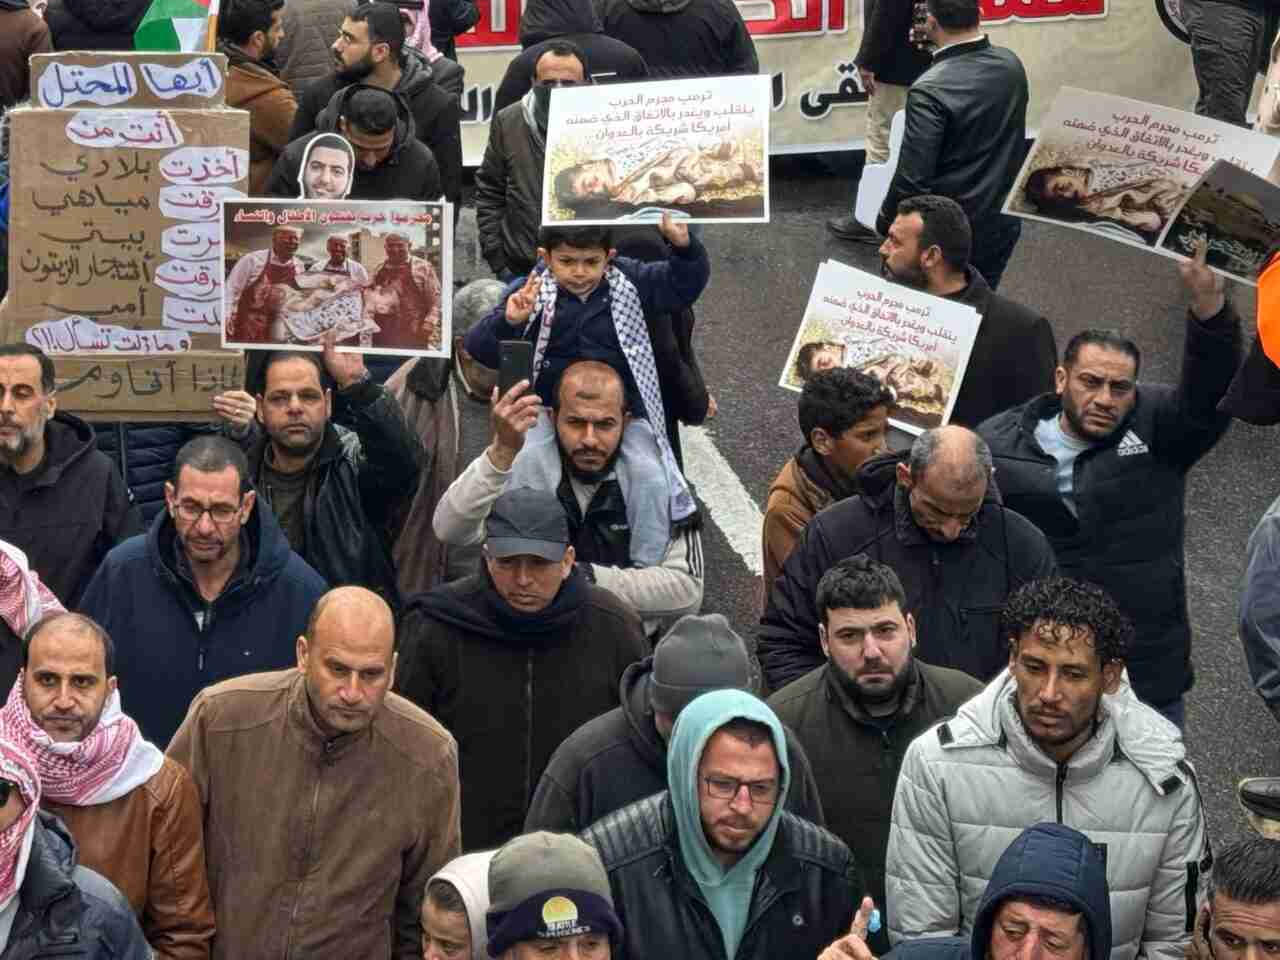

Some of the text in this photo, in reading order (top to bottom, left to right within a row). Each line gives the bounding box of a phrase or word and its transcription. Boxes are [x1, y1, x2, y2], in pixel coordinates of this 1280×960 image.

[43, 58, 217, 107] أيها المحتل
[566, 104, 754, 125] ينقلب ويغدر بالاتفاق الذي ضمنه
[608, 90, 712, 109] ترمب مجرم الحرب
[70, 111, 177, 144] أنت من
[595, 121, 731, 140] أمريكا شريكة بالعدوان
[1063, 118, 1209, 162] ويغدر بالاتفاق الذي ضمنه
[1112, 113, 1219, 145] ترمب مجرم الحرب
[1087, 138, 1137, 157] بالعدوان
[1137, 150, 1181, 170] شريكة
[39, 151, 151, 182] بلادي
[32, 184, 151, 216] مياهي
[20, 250, 80, 285] الزيتون
[77, 251, 156, 286] أشجار
[1117, 444, 1149, 457] adidas
